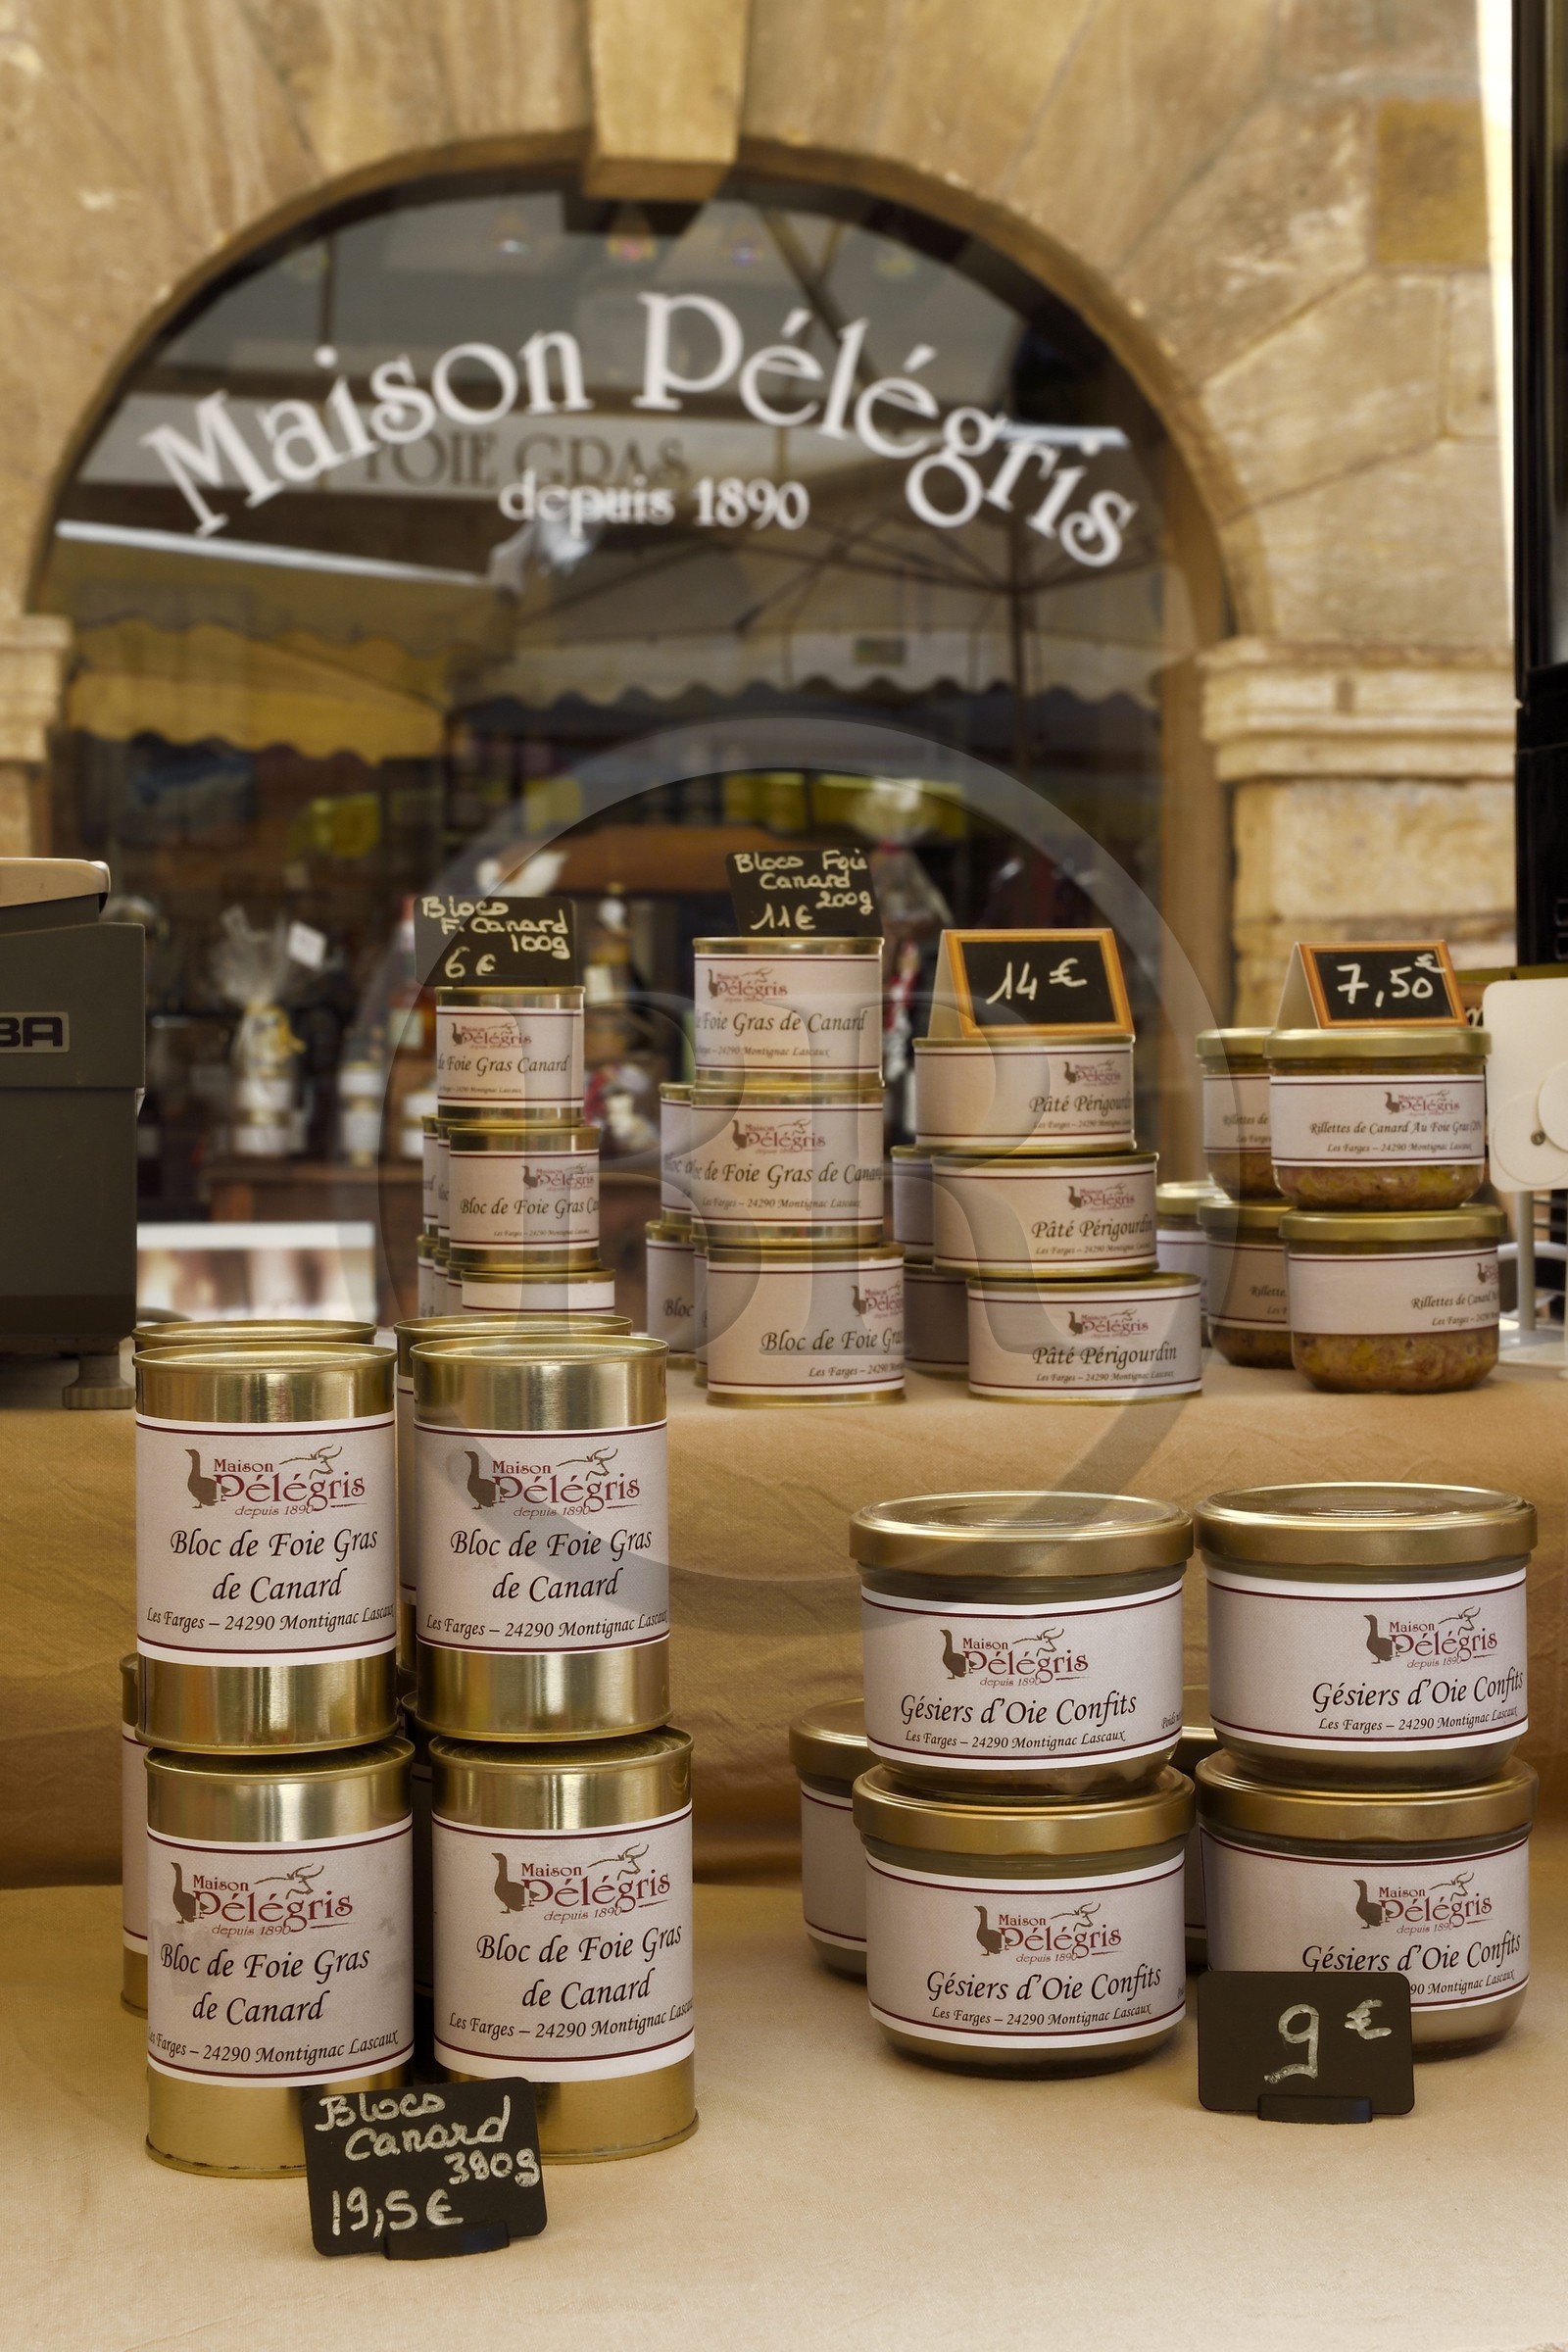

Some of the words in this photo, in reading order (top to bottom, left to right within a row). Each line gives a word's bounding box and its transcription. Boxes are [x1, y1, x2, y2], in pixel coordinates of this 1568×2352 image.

[138, 327, 593, 540] Maison
[634, 291, 1137, 568] Pélégris
[499, 468, 675, 538] depuis
[694, 477, 809, 530] 1890
[822, 849, 867, 870] Foie
[760, 869, 850, 890] Canard
[815, 891, 873, 915] 200g
[470, 908, 568, 934] Canard
[511, 934, 570, 959] 100g
[445, 946, 470, 978] 6
[717, 979, 788, 1002] Pélégris
[986, 961, 1037, 1004] 14
[1049, 957, 1087, 987] €
[704, 1011, 727, 1030] Foie
[733, 1012, 774, 1037] Gras
[780, 1010, 802, 1031] de
[808, 1010, 867, 1033] Canard
[743, 1046, 789, 1058] Montignac
[447, 1055, 471, 1071] Foie
[476, 1056, 512, 1077] Gras
[517, 1054, 569, 1073] Canard
[1029, 1095, 1069, 1113] Pâté
[1309, 1122, 1349, 1134] Rillettes
[1353, 1120, 1366, 1133] de
[1369, 1120, 1408, 1134] Canard
[1411, 1121, 1427, 1133] Au
[1431, 1121, 1449, 1132] Foie
[746, 1131, 826, 1153] Pélégris
[1343, 1145, 1370, 1153] Farges
[1381, 1144, 1406, 1152] 24290
[705, 1160, 717, 1181] de
[722, 1163, 759, 1182] Foie
[767, 1164, 812, 1189] Gras
[818, 1161, 837, 1182] de
[461, 1197, 487, 1215] Bloc
[491, 1198, 508, 1214] de
[514, 1200, 549, 1215] Foie
[555, 1199, 584, 1219] Gras
[714, 1199, 737, 1208] Farges
[777, 1200, 827, 1209] Montignac
[1031, 1219, 1074, 1239] Pâté
[1411, 1298, 1452, 1309] Rillettes
[760, 1329, 806, 1352] Bloc
[811, 1329, 834, 1350] de
[841, 1329, 877, 1349] Foie
[1081, 1319, 1149, 1337] Pélégris
[1032, 1347, 1074, 1364] Pâté
[1080, 1341, 1177, 1370] Périgourdin
[827, 1367, 858, 1379] Farges
[1051, 1374, 1075, 1384] Farges
[1110, 1373, 1149, 1382] Montignac
[215, 1459, 272, 1472] Maison
[493, 1460, 551, 1474] Maison
[214, 1471, 366, 1512] Pélégris
[493, 1473, 640, 1512] Pélégris
[171, 1528, 220, 1556] Bloc
[229, 1530, 258, 1556] de
[270, 1531, 324, 1556] Foie
[334, 1529, 377, 1562] Gras
[451, 1529, 501, 1555] Bloc
[509, 1530, 536, 1556] de
[547, 1531, 601, 1556] Foie
[611, 1530, 652, 1561] Gras
[213, 1573, 240, 1599] de
[251, 1568, 347, 1603] Canard
[493, 1572, 519, 1598] de
[529, 1567, 623, 1602] Canard
[164, 1611, 205, 1633] Farges
[224, 1616, 274, 1630] 24290
[279, 1613, 359, 1632] Montignac
[426, 1615, 441, 1630] Les
[444, 1618, 485, 1640] Farges
[505, 1623, 554, 1637] 24290
[559, 1620, 634, 1639] Montignac
[1390, 1622, 1434, 1639] Maison
[963, 1639, 1007, 1649] Maison
[1390, 1627, 1497, 1666] Pélégris
[964, 1649, 1089, 1684] Pélégris
[1313, 1683, 1399, 1713] Gésiers
[1408, 1679, 1466, 1705] d'Oie
[1471, 1669, 1524, 1714] Confits
[902, 1695, 973, 1725] Gésiers
[981, 1698, 1047, 1724] d'Oie
[1056, 1690, 1136, 1727] Confits
[1318, 1718, 1339, 1730] Les
[1343, 1719, 1383, 1734] Farges
[1398, 1718, 1434, 1730] 24290
[1437, 1715, 1490, 1729] Montignac
[906, 1731, 920, 1741] Les
[923, 1733, 956, 1749] Farges
[972, 1737, 1008, 1747] 24290
[1012, 1738, 1077, 1751] Montignac
[1081, 1732, 1125, 1744] Lascaux
[521, 1863, 581, 1877] Maison
[193, 1875, 249, 1891] Maison
[522, 1868, 671, 1915] Pélégris
[1380, 1887, 1425, 1897] Maison
[193, 1888, 354, 1932] Pélégris
[1000, 1914, 1046, 1926] Maison
[1380, 1892, 1493, 1932] Pélégris
[477, 1934, 530, 1962] Bloc
[539, 1935, 567, 1962] de
[579, 1933, 633, 1961] Foie
[643, 1926, 681, 1962] Gras
[1000, 1925, 1121, 1959] Pélégris
[162, 1943, 200, 1974] Bloc
[207, 1949, 233, 1977] de
[244, 1952, 303, 1978] Foie
[315, 1950, 369, 1984] Gras
[1300, 1942, 1391, 1973] Gésiers
[1397, 1944, 1459, 1971] d'Oie
[1469, 1933, 1520, 1977] Confits
[522, 1979, 551, 2006] de
[562, 1968, 655, 2009] Canard
[927, 1971, 1008, 2001] Gésiers
[1016, 1975, 1082, 2000] d'Oie
[1092, 1963, 1160, 2001] Confits
[1428, 1980, 1483, 1994] Montignac
[193, 1992, 218, 2020] de
[226, 1990, 330, 2025] Canard
[932, 2007, 950, 2019] Les
[954, 2010, 991, 2026] Farges
[1007, 2014, 1044, 2025] 24290
[1048, 2013, 1109, 2027] Montignac
[1113, 2005, 1152, 2019] Lascaux
[1345, 1999, 1393, 2040] €
[450, 2013, 466, 2029] Les
[470, 2018, 514, 2040] Farges
[535, 2022, 586, 2037] 24290
[591, 2013, 666, 2036] Montignac
[158, 2034, 186, 2058] Farges
[204, 2045, 250, 2062] 24290
[255, 2045, 344, 2066] Montignac
[348, 2029, 399, 2055] Lascaux
[345, 2094, 511, 2161] Canard
